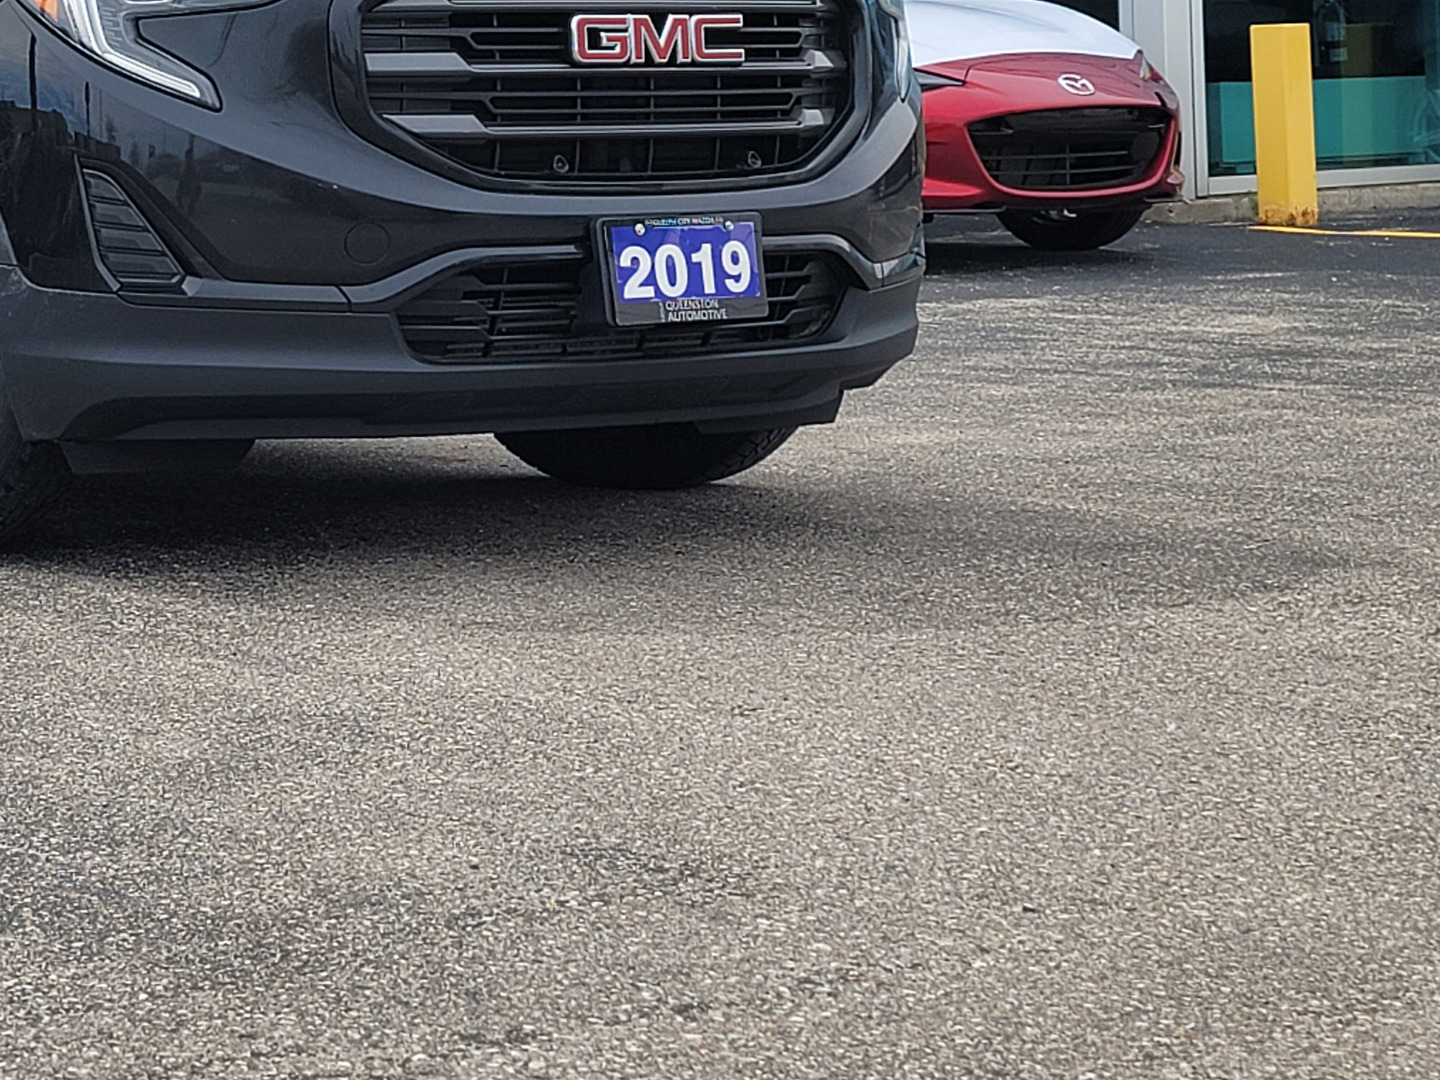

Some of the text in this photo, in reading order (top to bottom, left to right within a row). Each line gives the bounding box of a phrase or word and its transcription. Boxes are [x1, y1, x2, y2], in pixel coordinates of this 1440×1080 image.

[570, 14, 745, 64] GMC
[619, 239, 752, 300] 2019
[667, 308, 728, 322] AUTOMOTIVE
